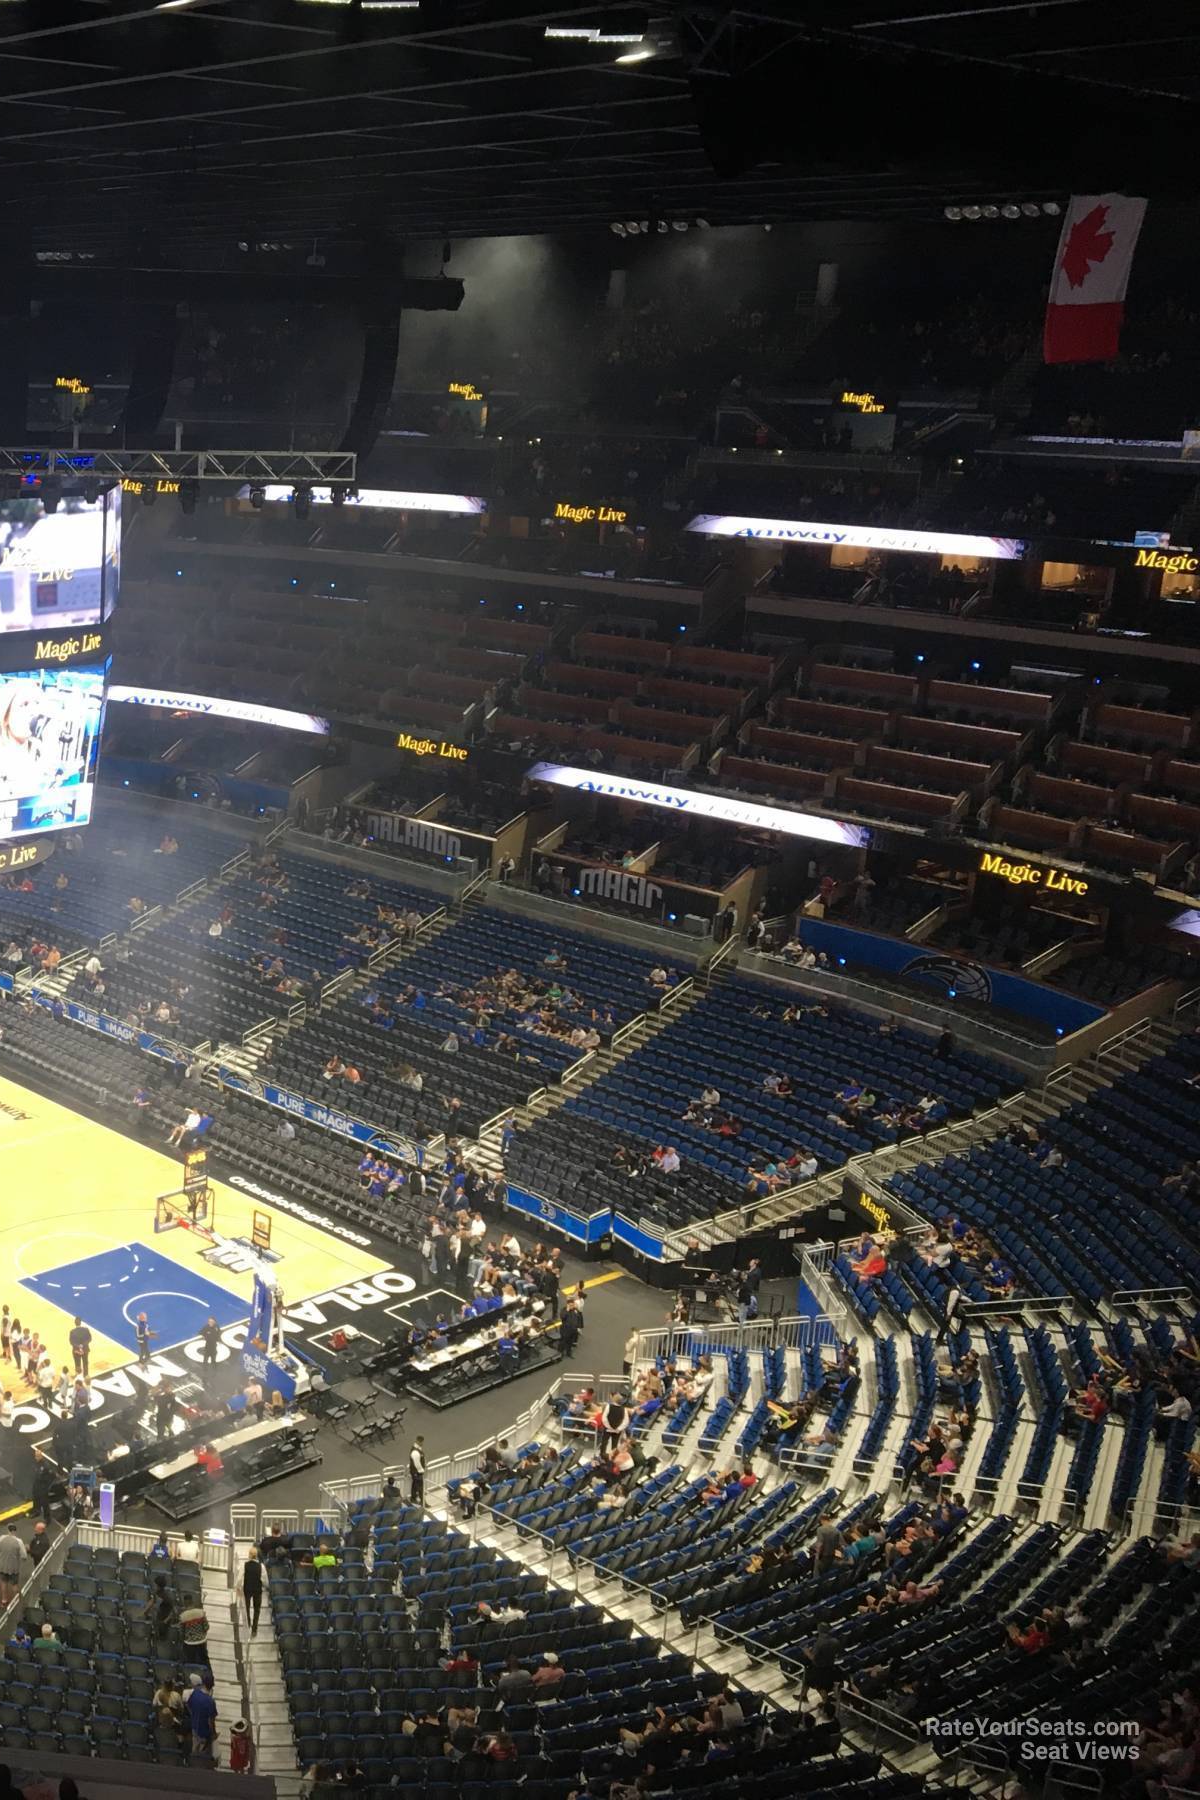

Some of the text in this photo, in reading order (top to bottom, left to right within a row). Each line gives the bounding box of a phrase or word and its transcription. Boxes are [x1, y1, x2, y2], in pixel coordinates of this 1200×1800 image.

[56, 377, 81, 389] Magic
[71, 383, 90, 394] Live
[449, 383, 475, 396] Magic
[465, 390, 483, 401] Live
[842, 392, 875, 407] Magic
[862, 401, 885, 413] Live
[118, 478, 148, 494] Mag
[555, 503, 627, 523] Magic Live
[735, 527, 848, 543] Amway
[1135, 549, 1199, 574] Magic
[36, 633, 102, 661] Magic Live
[123, 695, 213, 712] Amway
[397, 733, 469, 761] Magic Live
[575, 780, 689, 808] Amway
[367, 814, 461, 857] ORLANDO
[10, 845, 37, 866] Live
[980, 852, 1089, 896] Magic Live
[580, 867, 662, 908] MAGIC
[77, 1009, 100, 1028] PURE
[277, 1092, 355, 1135] PURE MAGIC
[228, 1175, 373, 1246] OrlandoMagic.com
[860, 1193, 891, 1223] Magic
[184, 1271, 418, 1364] ORLADO
